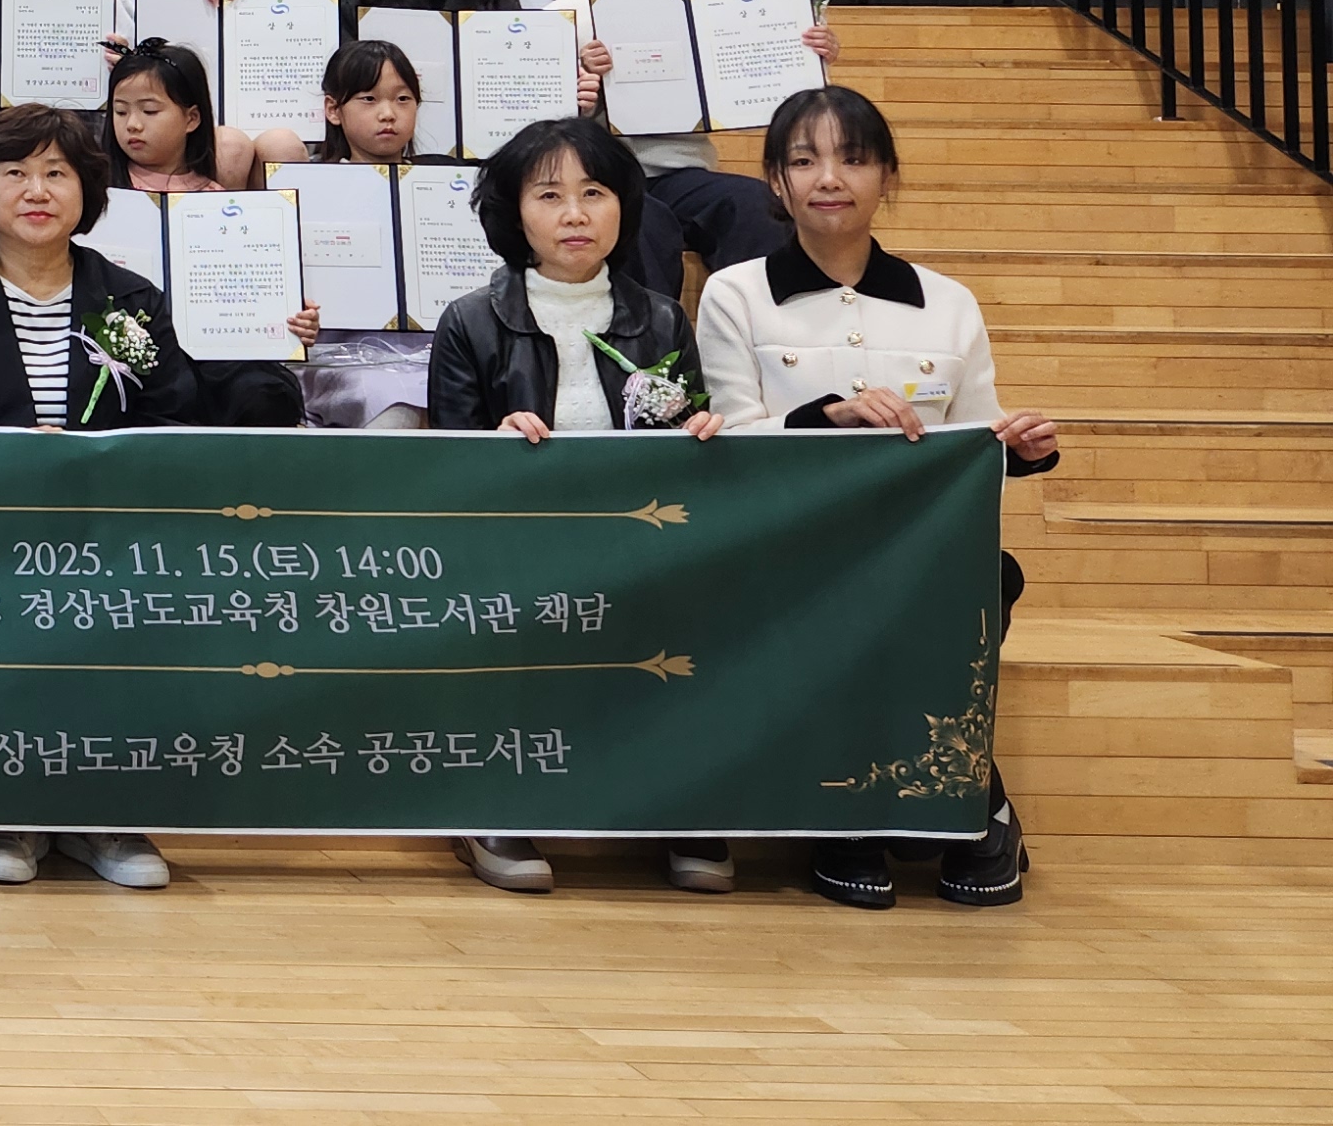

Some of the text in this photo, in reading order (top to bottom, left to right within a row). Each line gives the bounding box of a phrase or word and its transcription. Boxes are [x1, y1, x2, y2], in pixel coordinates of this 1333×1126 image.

[12, 541, 114, 578] 2025.
[127, 542, 183, 578] 11.
[195, 541, 321, 582] 15.(토)
[336, 546, 444, 580] 14:00
[19, 588, 300, 634] 경상남도교육청
[316, 591, 522, 636] 창원도서관
[533, 592, 610, 636] 책담
[260, 732, 346, 775] 소속
[357, 728, 572, 775] 공공도서관
